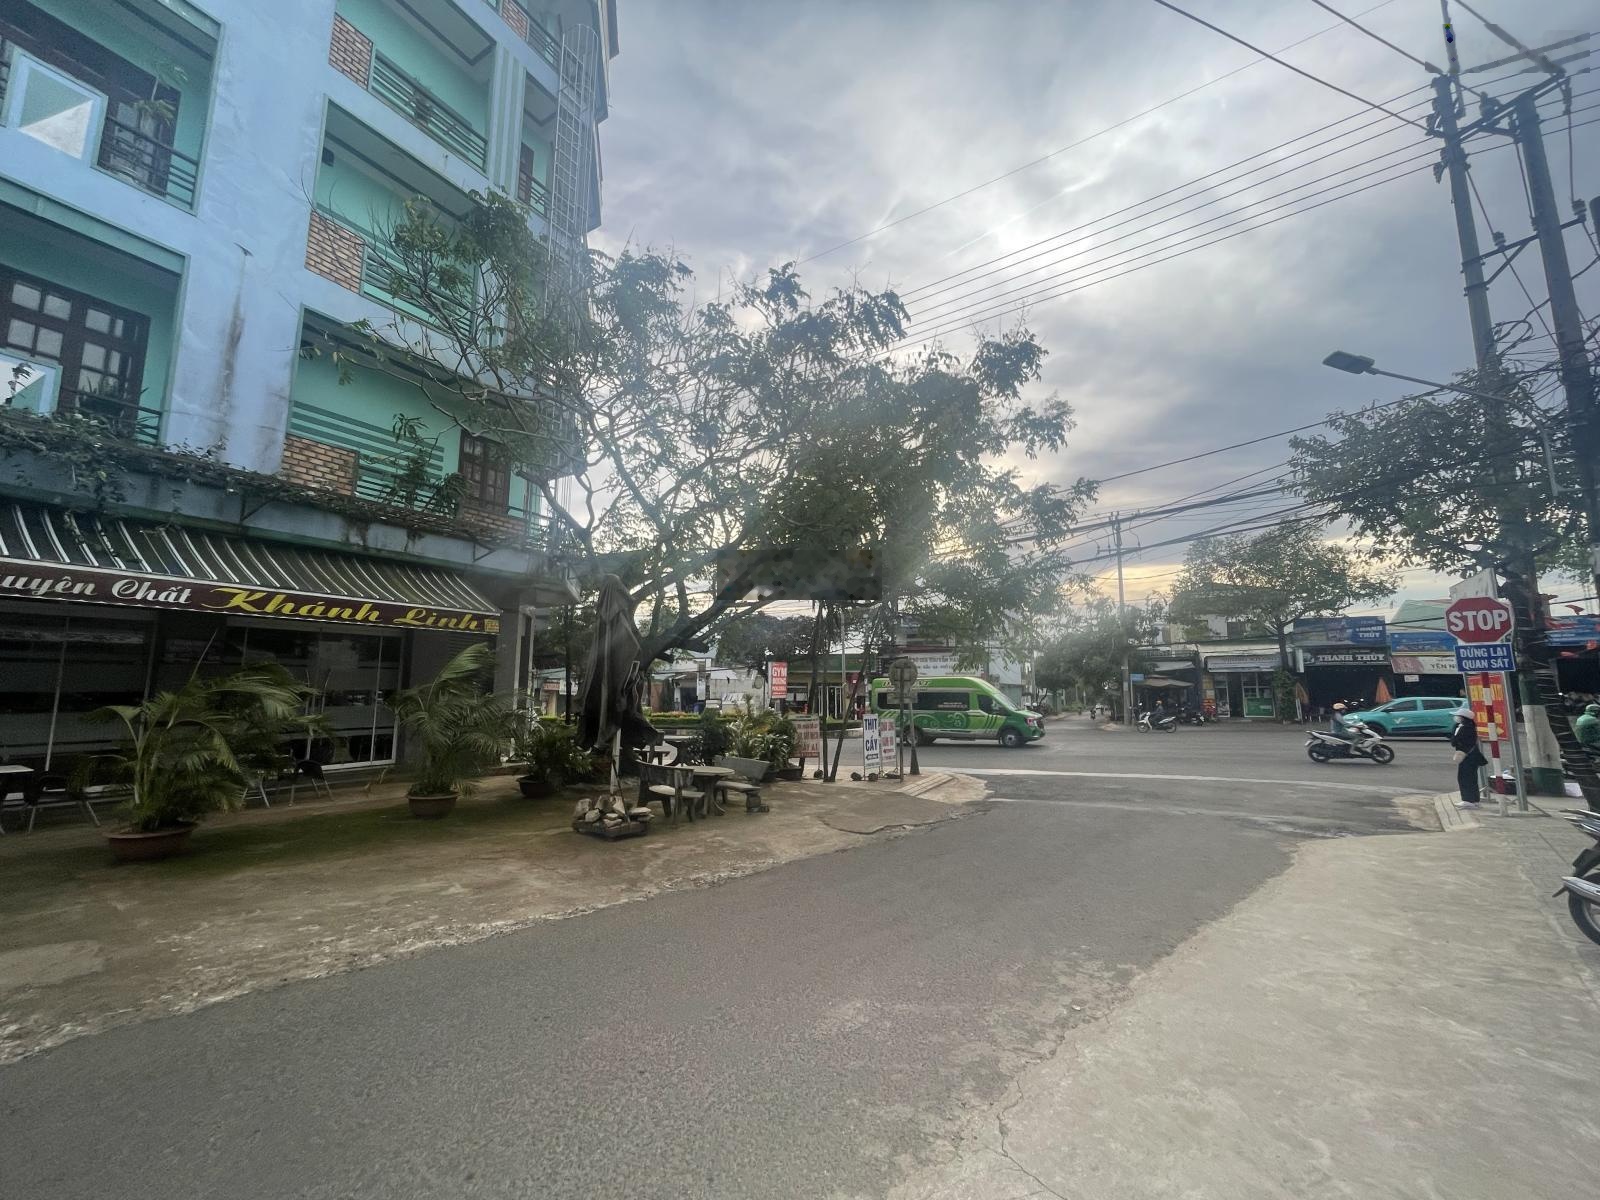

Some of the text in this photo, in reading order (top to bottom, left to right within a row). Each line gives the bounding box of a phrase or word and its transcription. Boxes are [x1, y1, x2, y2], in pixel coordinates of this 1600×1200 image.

[0, 575, 97, 596] uyên
[112, 578, 192, 605] Chất
[201, 588, 382, 623] Khánh
[393, 608, 477, 630] Linh
[1448, 609, 1508, 632] STOP
[1462, 656, 1509, 670] QUAN SÁT
[772, 667, 787, 677] GYM
[864, 718, 878, 733] THỊT
